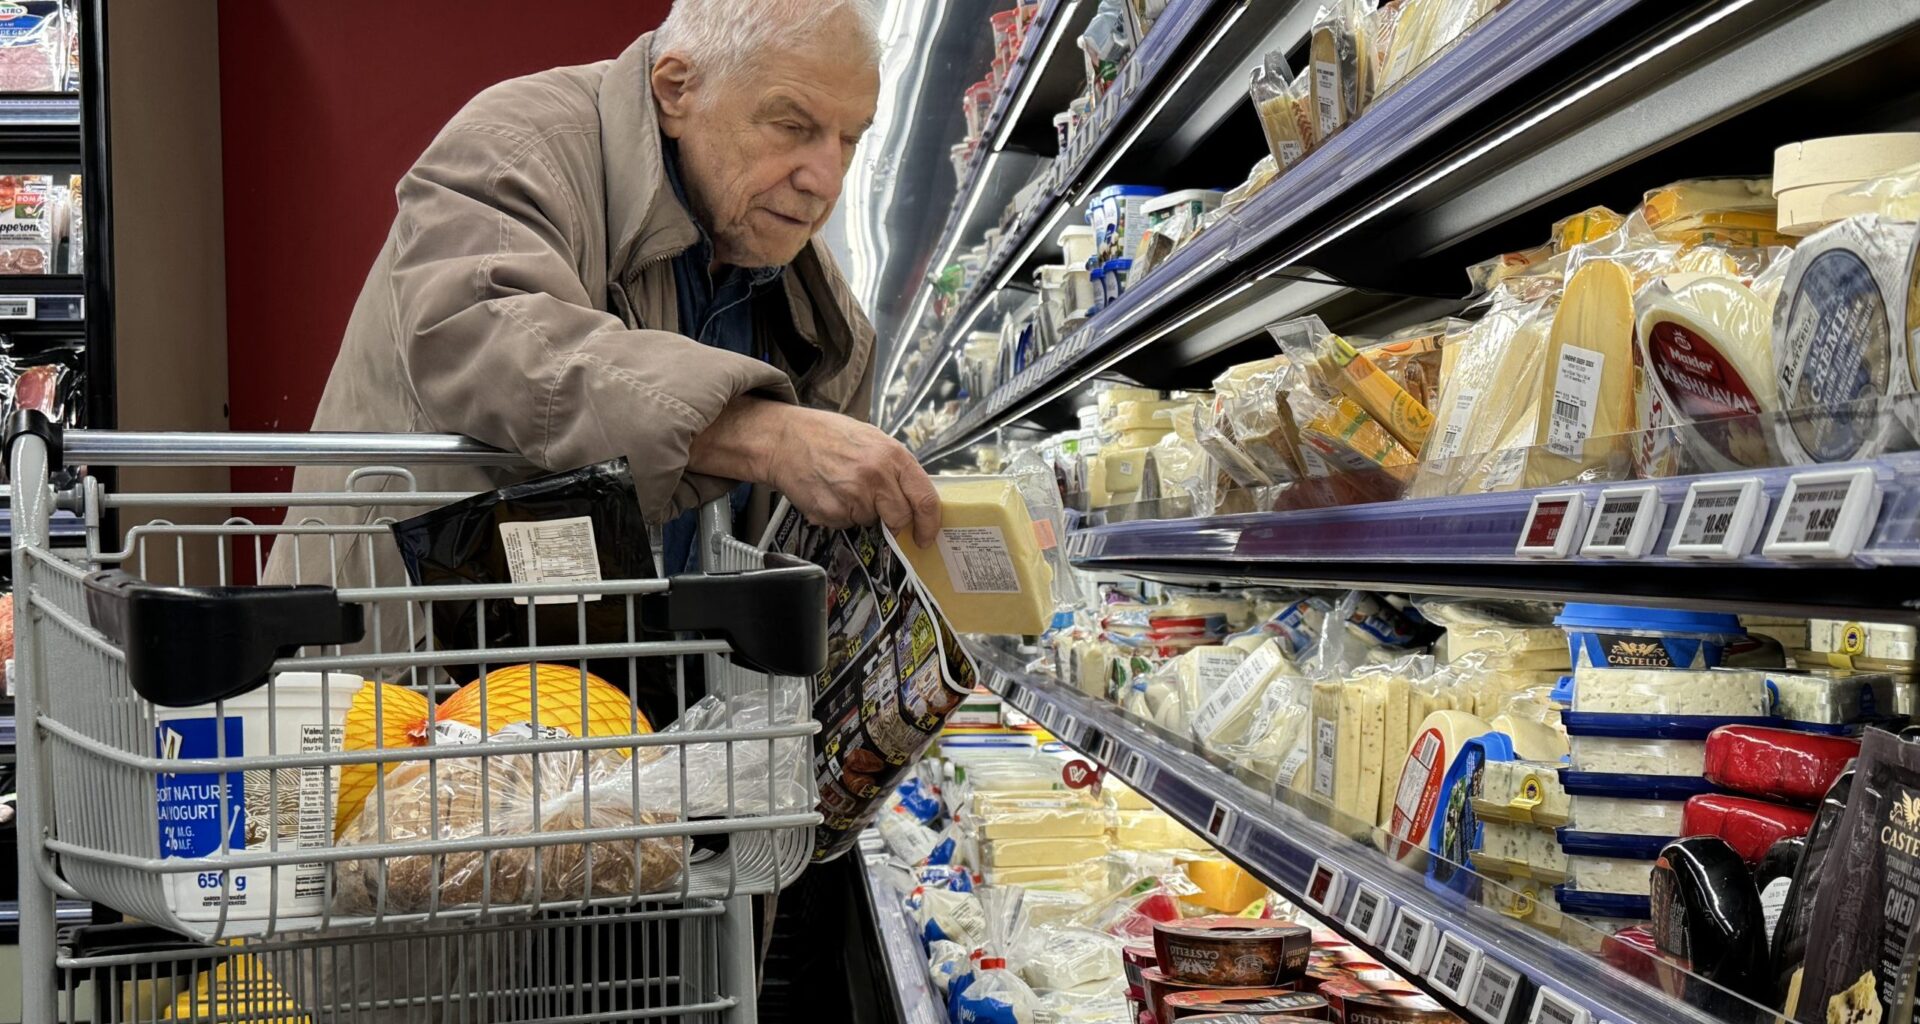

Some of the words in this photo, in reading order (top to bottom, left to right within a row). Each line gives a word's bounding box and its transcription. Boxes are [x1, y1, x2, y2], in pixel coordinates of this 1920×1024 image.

[0, 223, 41, 233] pperon
[1658, 363, 1757, 416] KASHKAVAL
[1607, 655, 1669, 667] CASTELLO
[1881, 825, 1920, 857] CASTE
[235, 875, 246, 891] g
[1884, 887, 1916, 927] CHED
